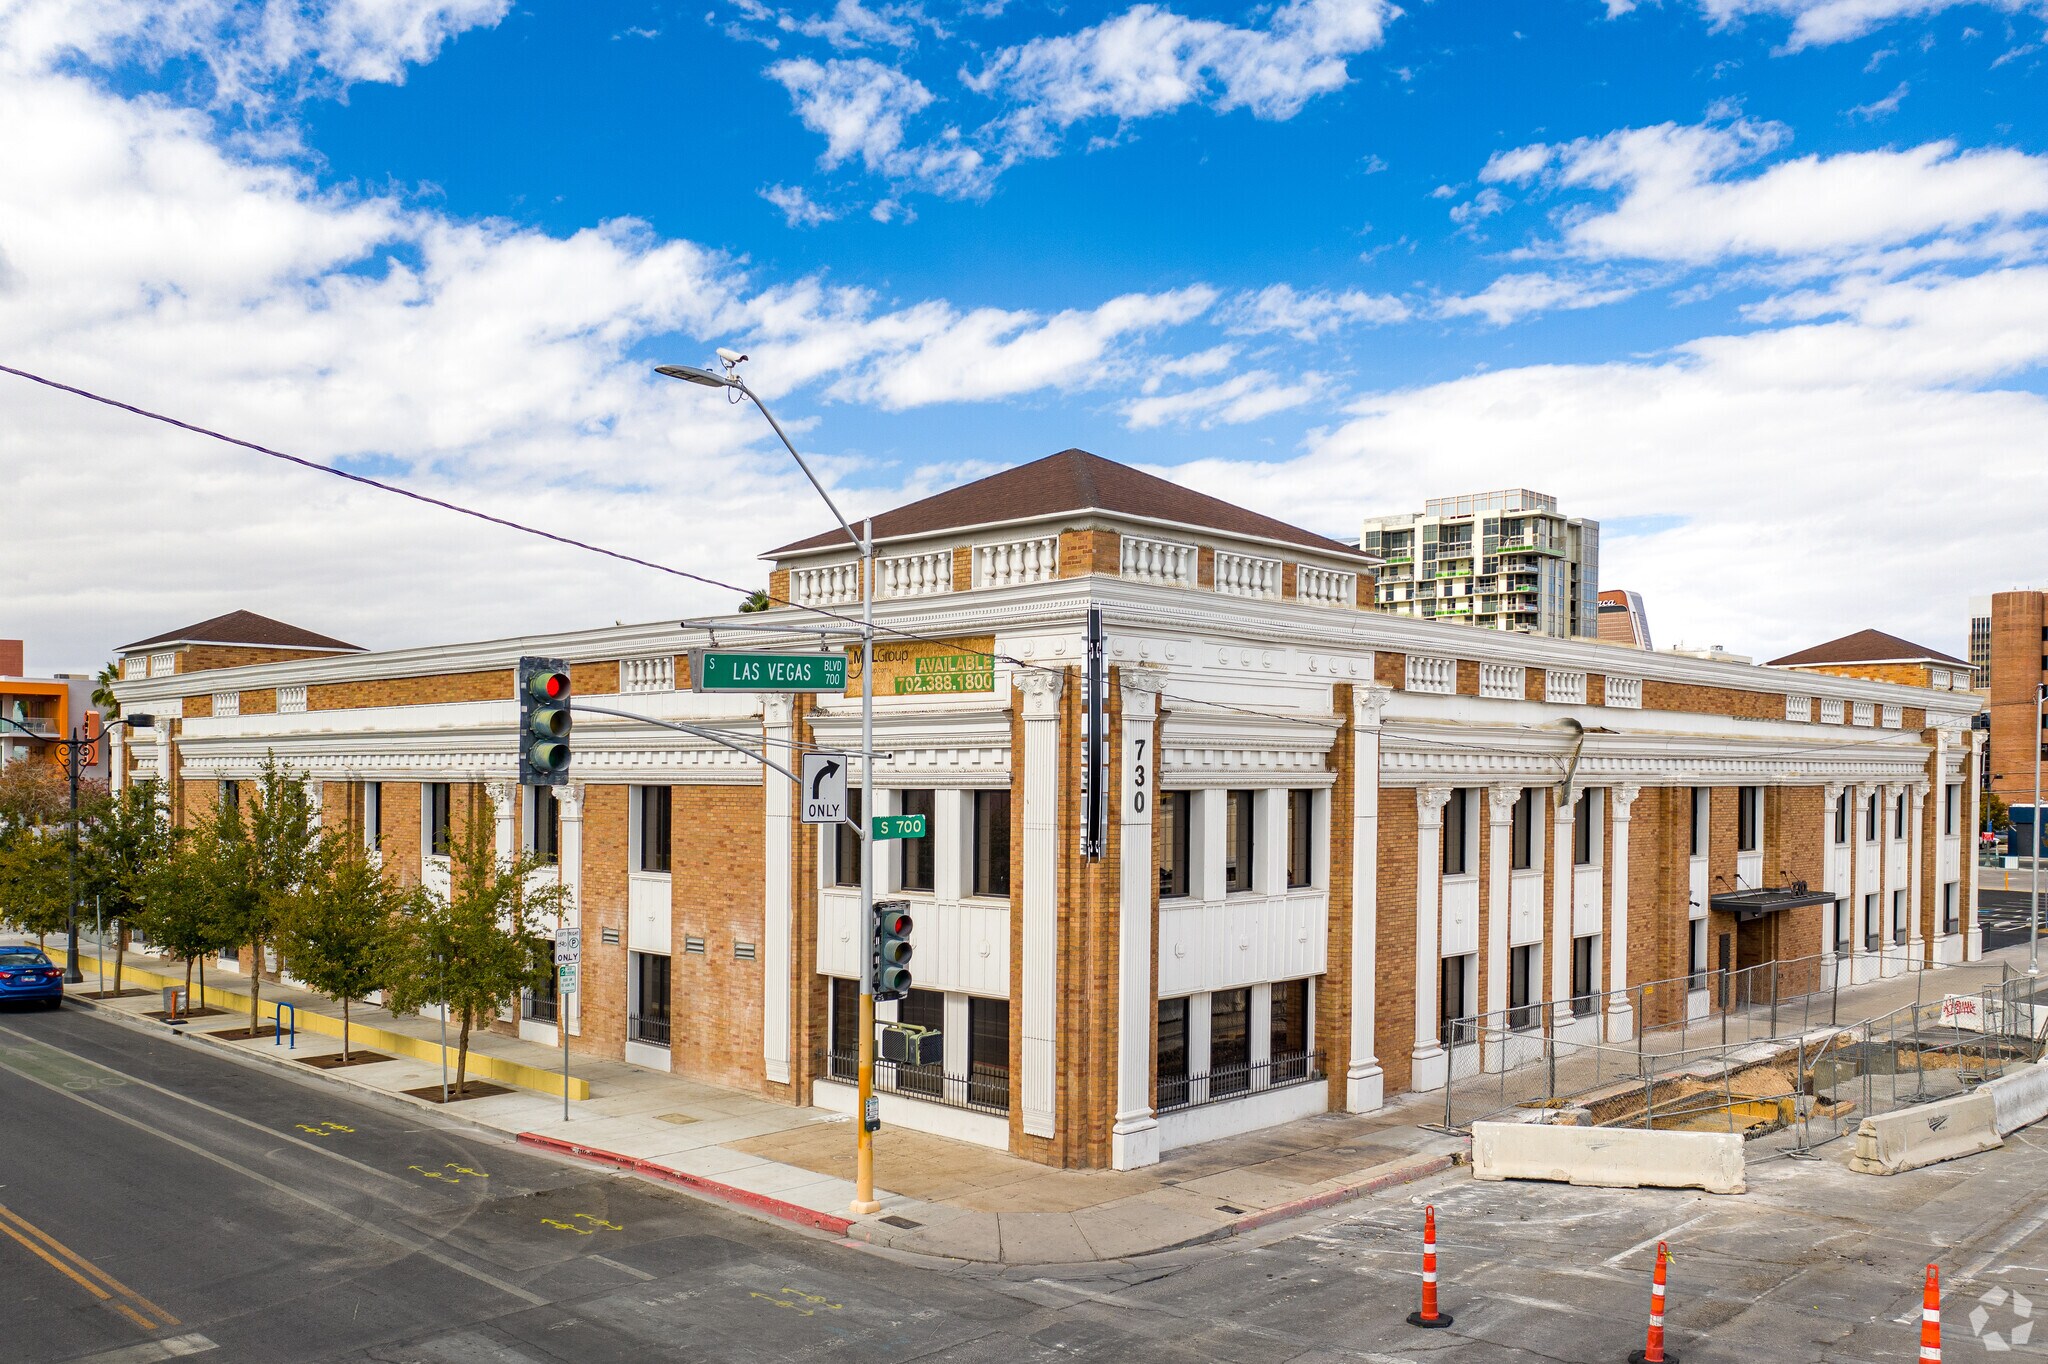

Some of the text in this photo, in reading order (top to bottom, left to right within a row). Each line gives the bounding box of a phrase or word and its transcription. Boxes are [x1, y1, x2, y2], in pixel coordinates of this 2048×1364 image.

[854, 648, 909, 664] MLGroup
[919, 655, 992, 673] AVAILABLE
[709, 657, 715, 669] S
[733, 662, 760, 680] LAS
[768, 662, 811, 681] VEGAS
[824, 660, 842, 672] BLVD
[825, 673, 840, 685] 700
[897, 673, 992, 693] 702.388.1800
[1134, 739, 1146, 814] 730
[808, 804, 839, 817] ONLY
[880, 820, 921, 834] S 700
[557, 953, 579, 961] ONLY
